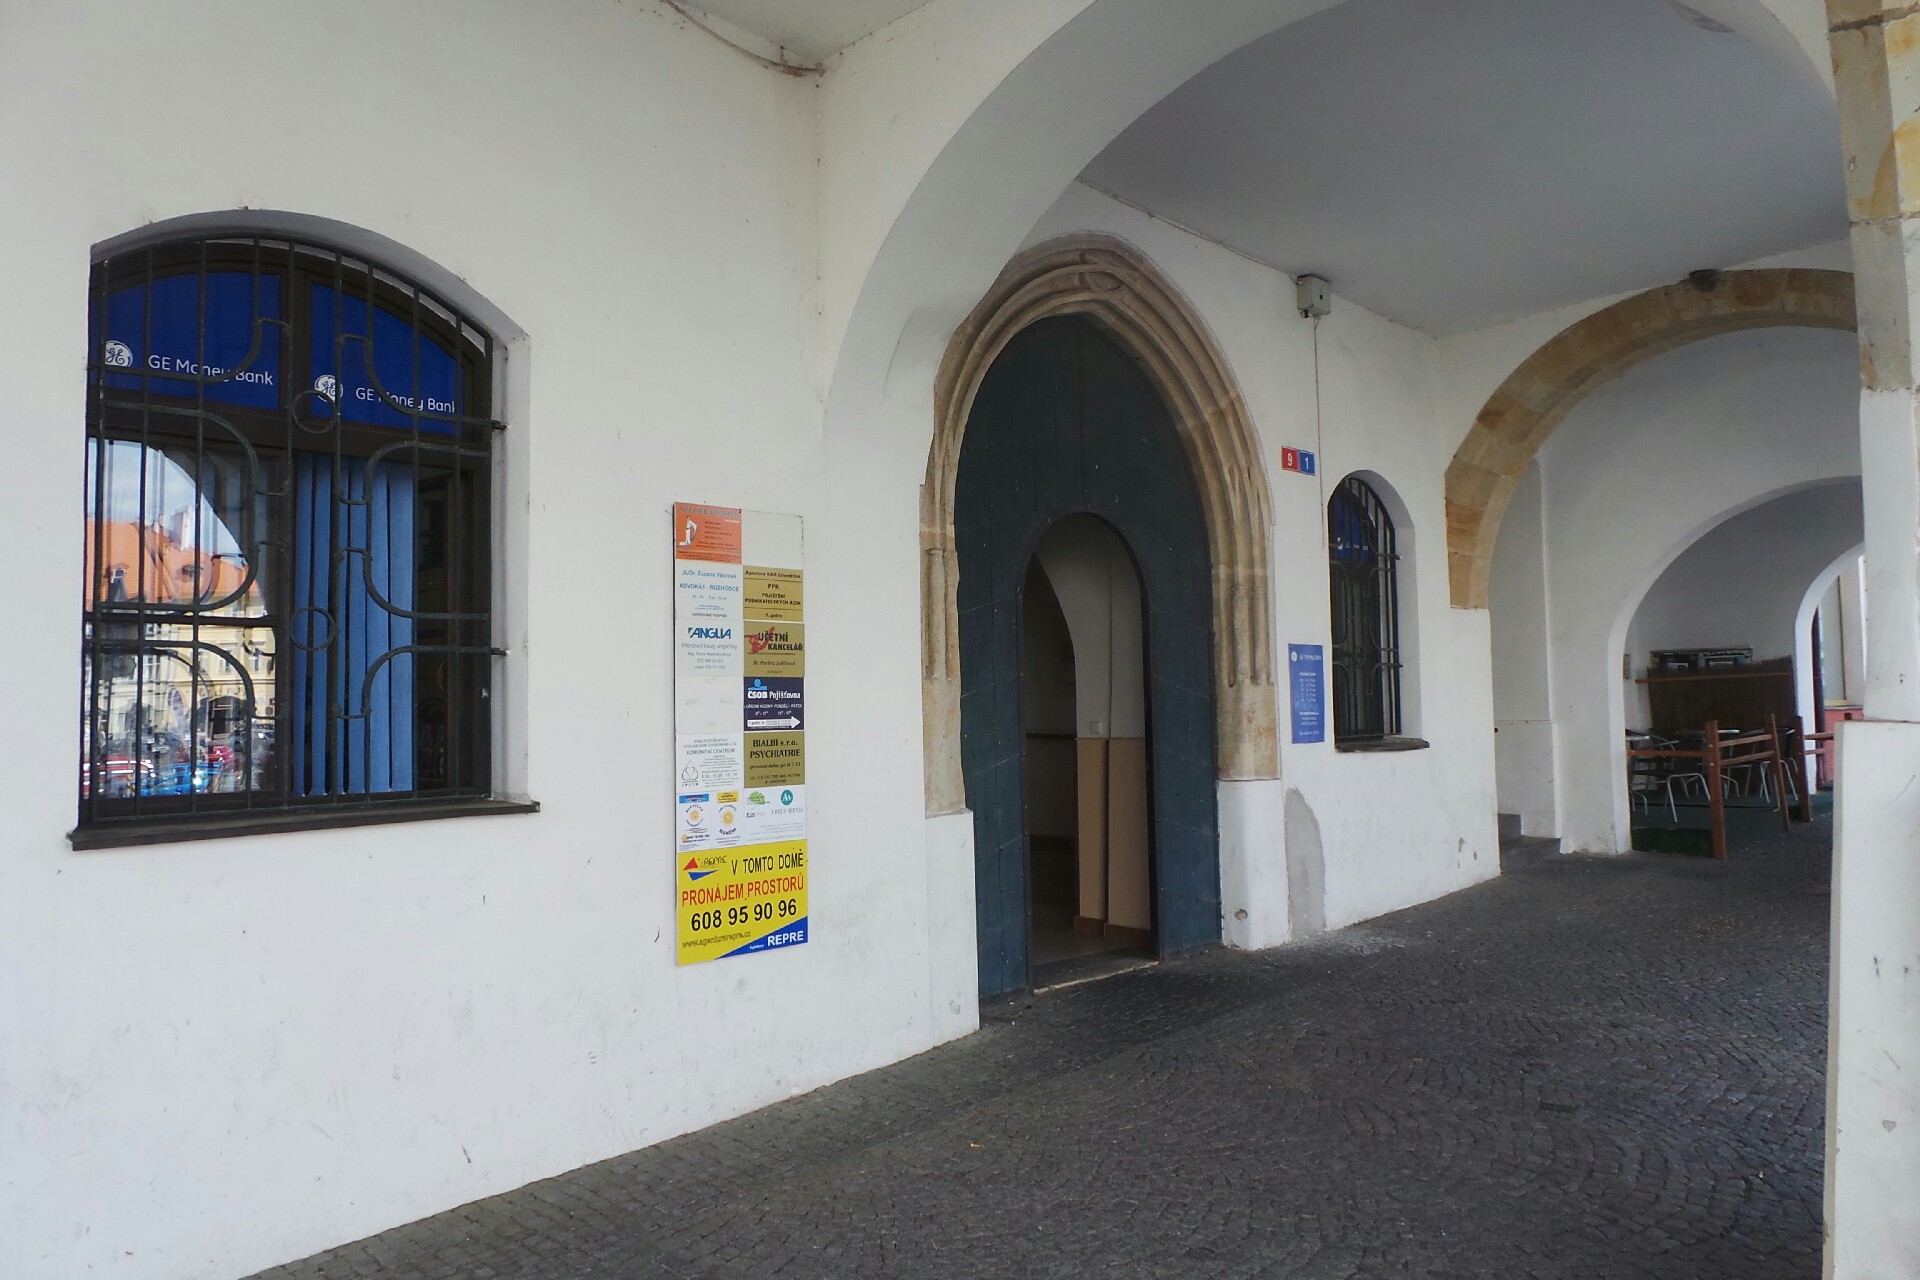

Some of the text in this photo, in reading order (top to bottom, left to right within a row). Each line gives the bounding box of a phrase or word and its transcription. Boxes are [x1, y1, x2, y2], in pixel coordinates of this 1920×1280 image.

[148, 354, 171, 371] GE
[355, 387, 375, 401] GE
[378, 391, 424, 411] oney
[1287, 452, 1293, 467] 9
[1304, 456, 1309, 470] 1
[697, 570, 716, 578] Zuzana
[679, 582, 705, 590] ADVOKÁT
[709, 584, 739, 592] ROZHODCE
[688, 627, 732, 640] ANGLIA
[767, 643, 804, 652] KANCELÁŘ
[747, 690, 801, 701] ČSOB Pojišťovna
[752, 738, 779, 748] BIALBI
[749, 748, 801, 759] PSYCHIATRIE
[731, 848, 804, 876] V TOMTO DOMĚ
[681, 871, 805, 907] PRONÁJEM PROSTORŮ
[691, 898, 798, 932] 608 95 90 96
[767, 929, 804, 948] REPRE
